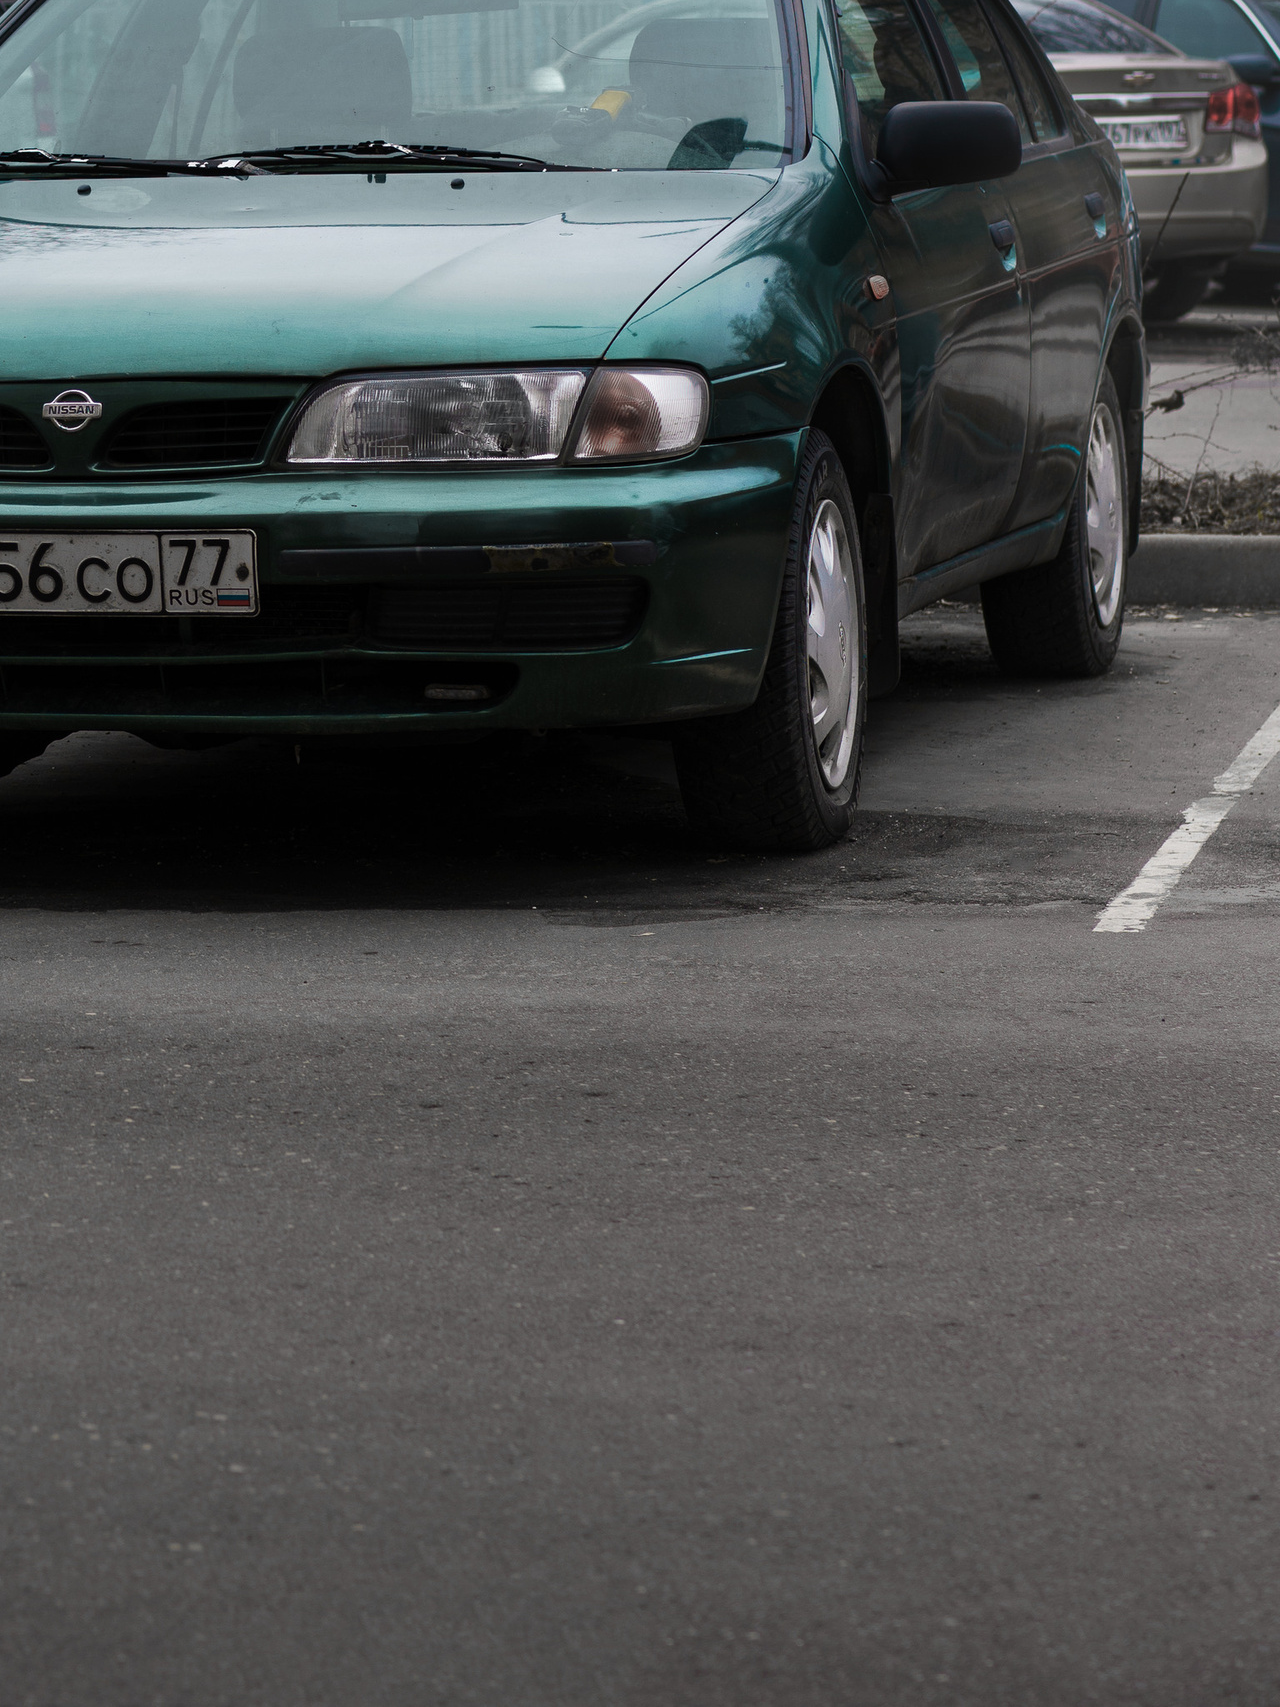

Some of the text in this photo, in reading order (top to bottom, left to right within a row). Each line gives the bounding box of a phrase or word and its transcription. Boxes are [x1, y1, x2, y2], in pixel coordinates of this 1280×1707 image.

[48, 405, 95, 415] NISSAN
[168, 538, 231, 586] 77
[169, 589, 215, 606] RUS
